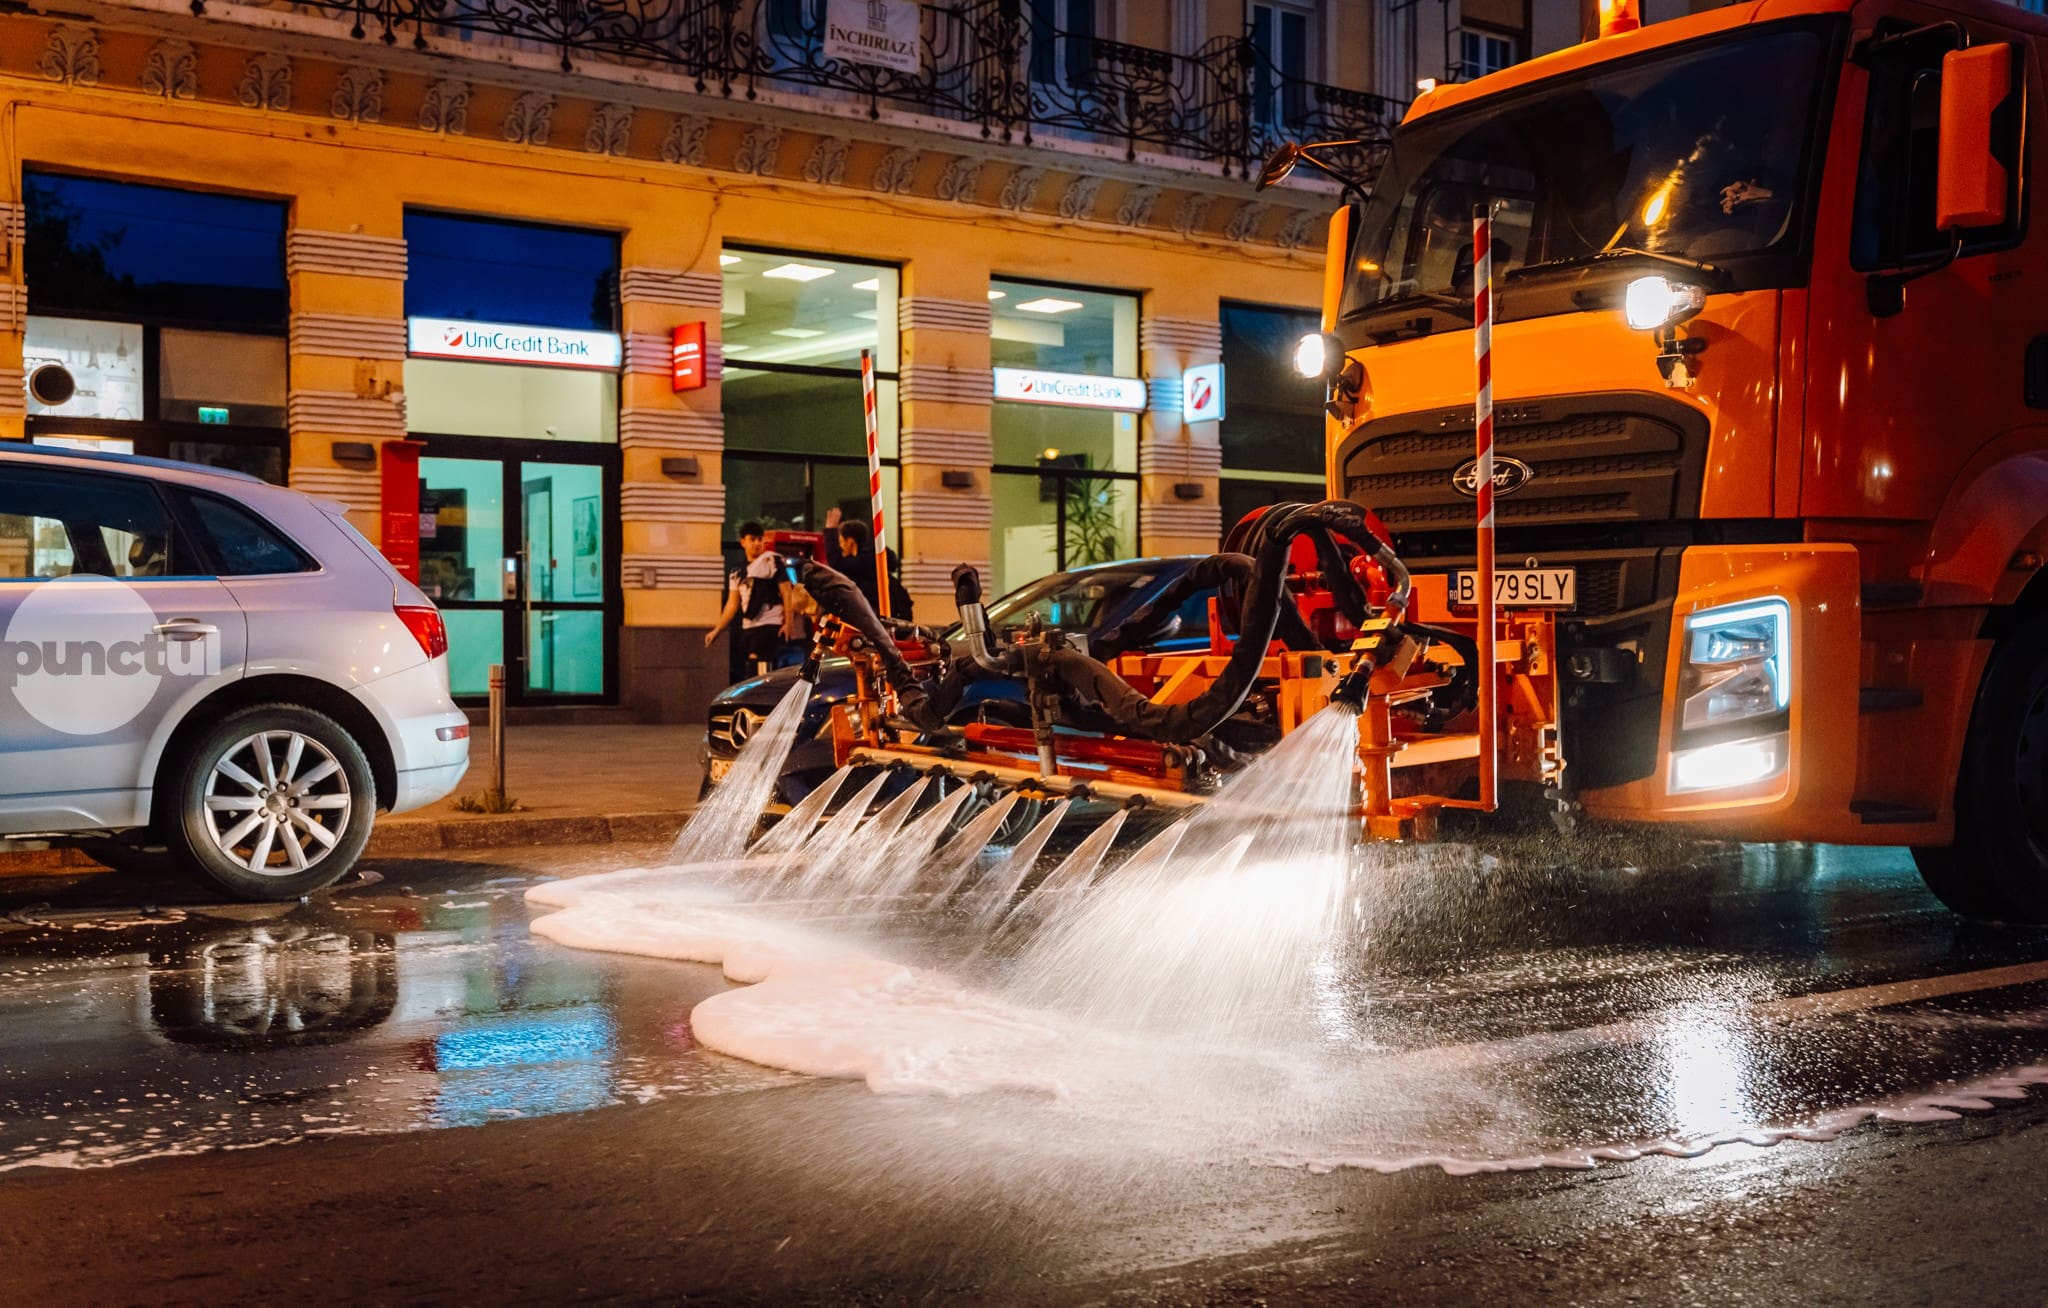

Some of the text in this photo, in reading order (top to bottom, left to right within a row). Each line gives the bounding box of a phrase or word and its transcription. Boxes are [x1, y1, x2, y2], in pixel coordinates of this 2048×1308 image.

[830, 24, 916, 57] ÎNCHIRIAZĂ
[466, 330, 589, 356] UniCredit Bank
[1035, 379, 1123, 400] UniCredit Bank
[1466, 463, 1511, 490] Frd
[1449, 590, 1458, 600] RO
[1489, 574, 1519, 600] 79
[1524, 573, 1569, 600] SLY
